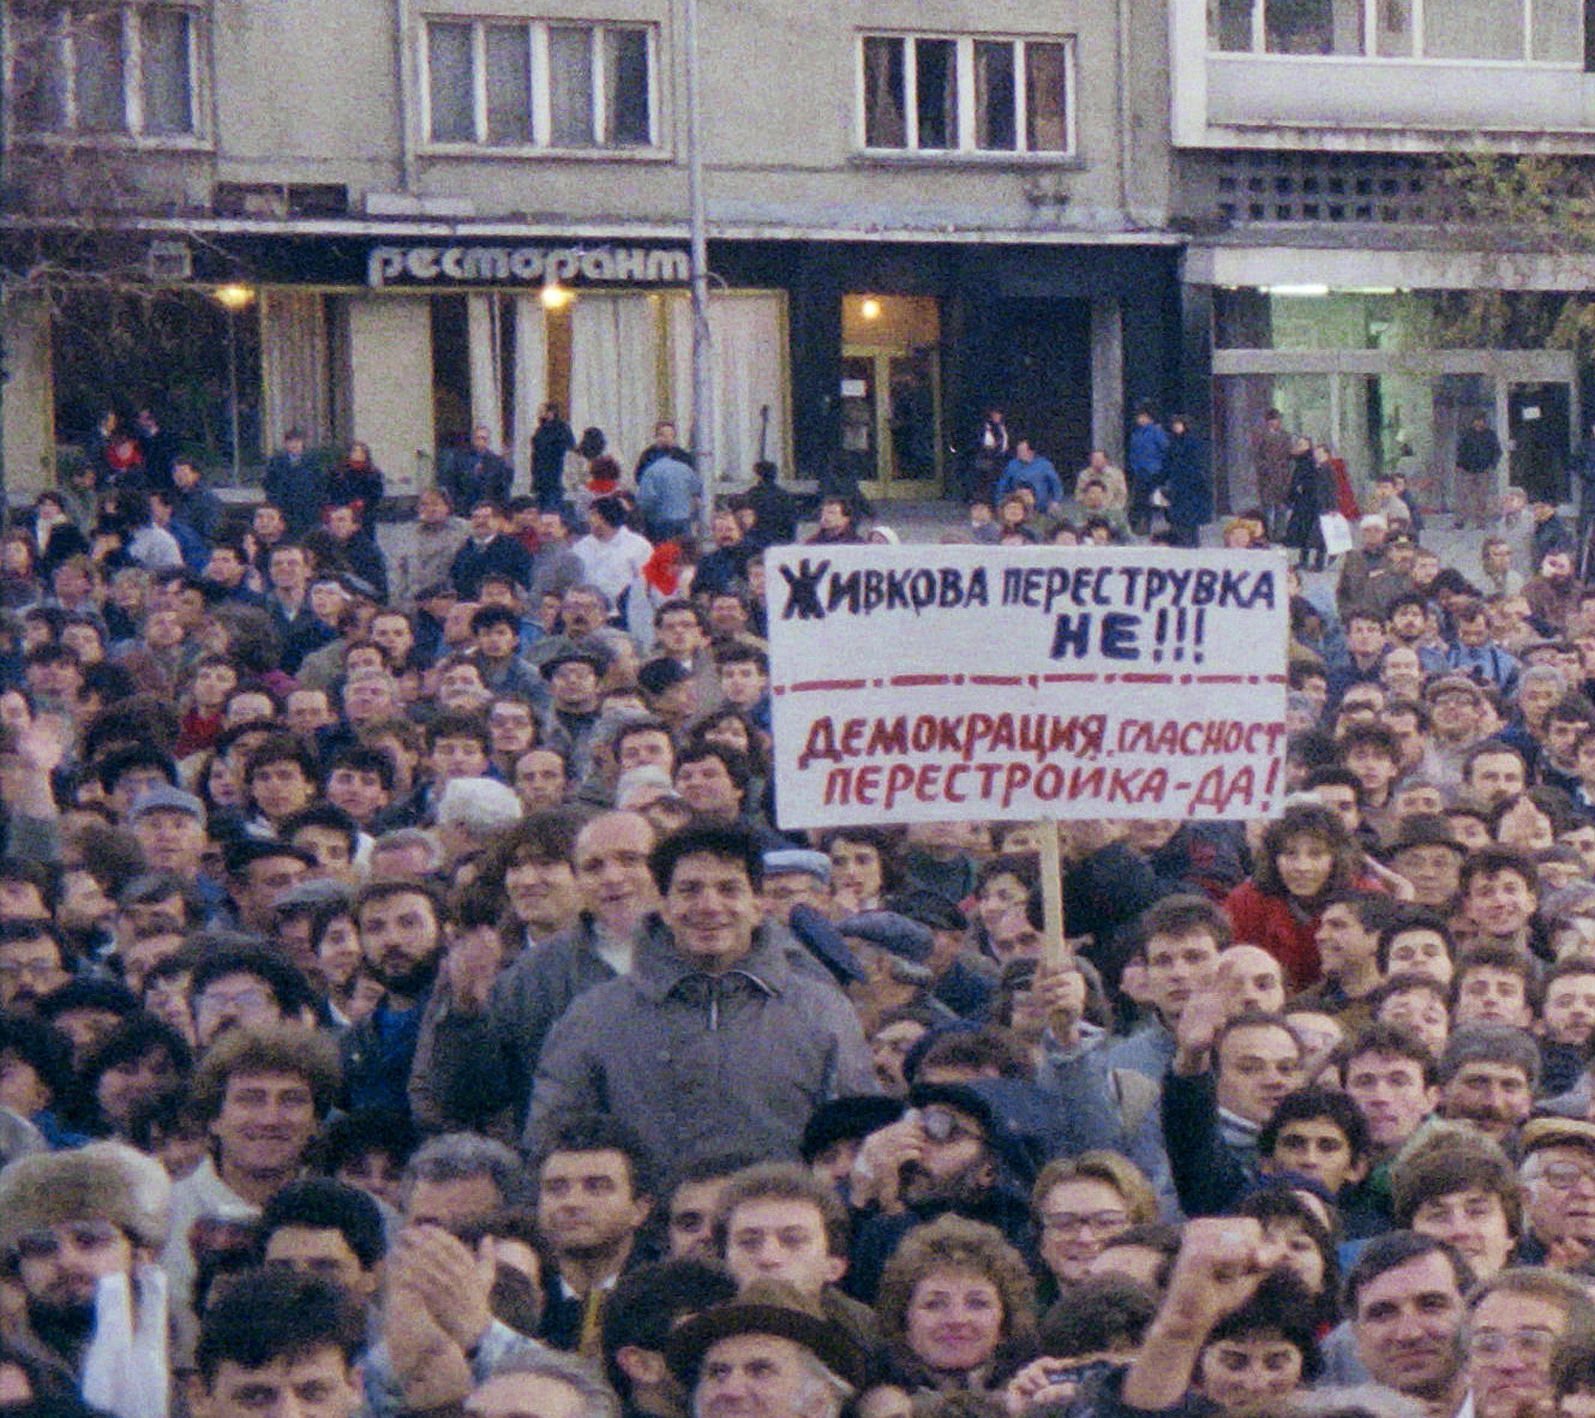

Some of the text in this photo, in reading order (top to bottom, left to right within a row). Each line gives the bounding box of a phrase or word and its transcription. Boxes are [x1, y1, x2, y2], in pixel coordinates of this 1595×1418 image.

[368, 245, 691, 287] ресторант
[779, 558, 1276, 620] ЖИВКОВА ПЕРЕСТРУВКА
[1050, 607, 1206, 664] НЕ!!!
[1117, 719, 1286, 757] ГЛАСНОСТ
